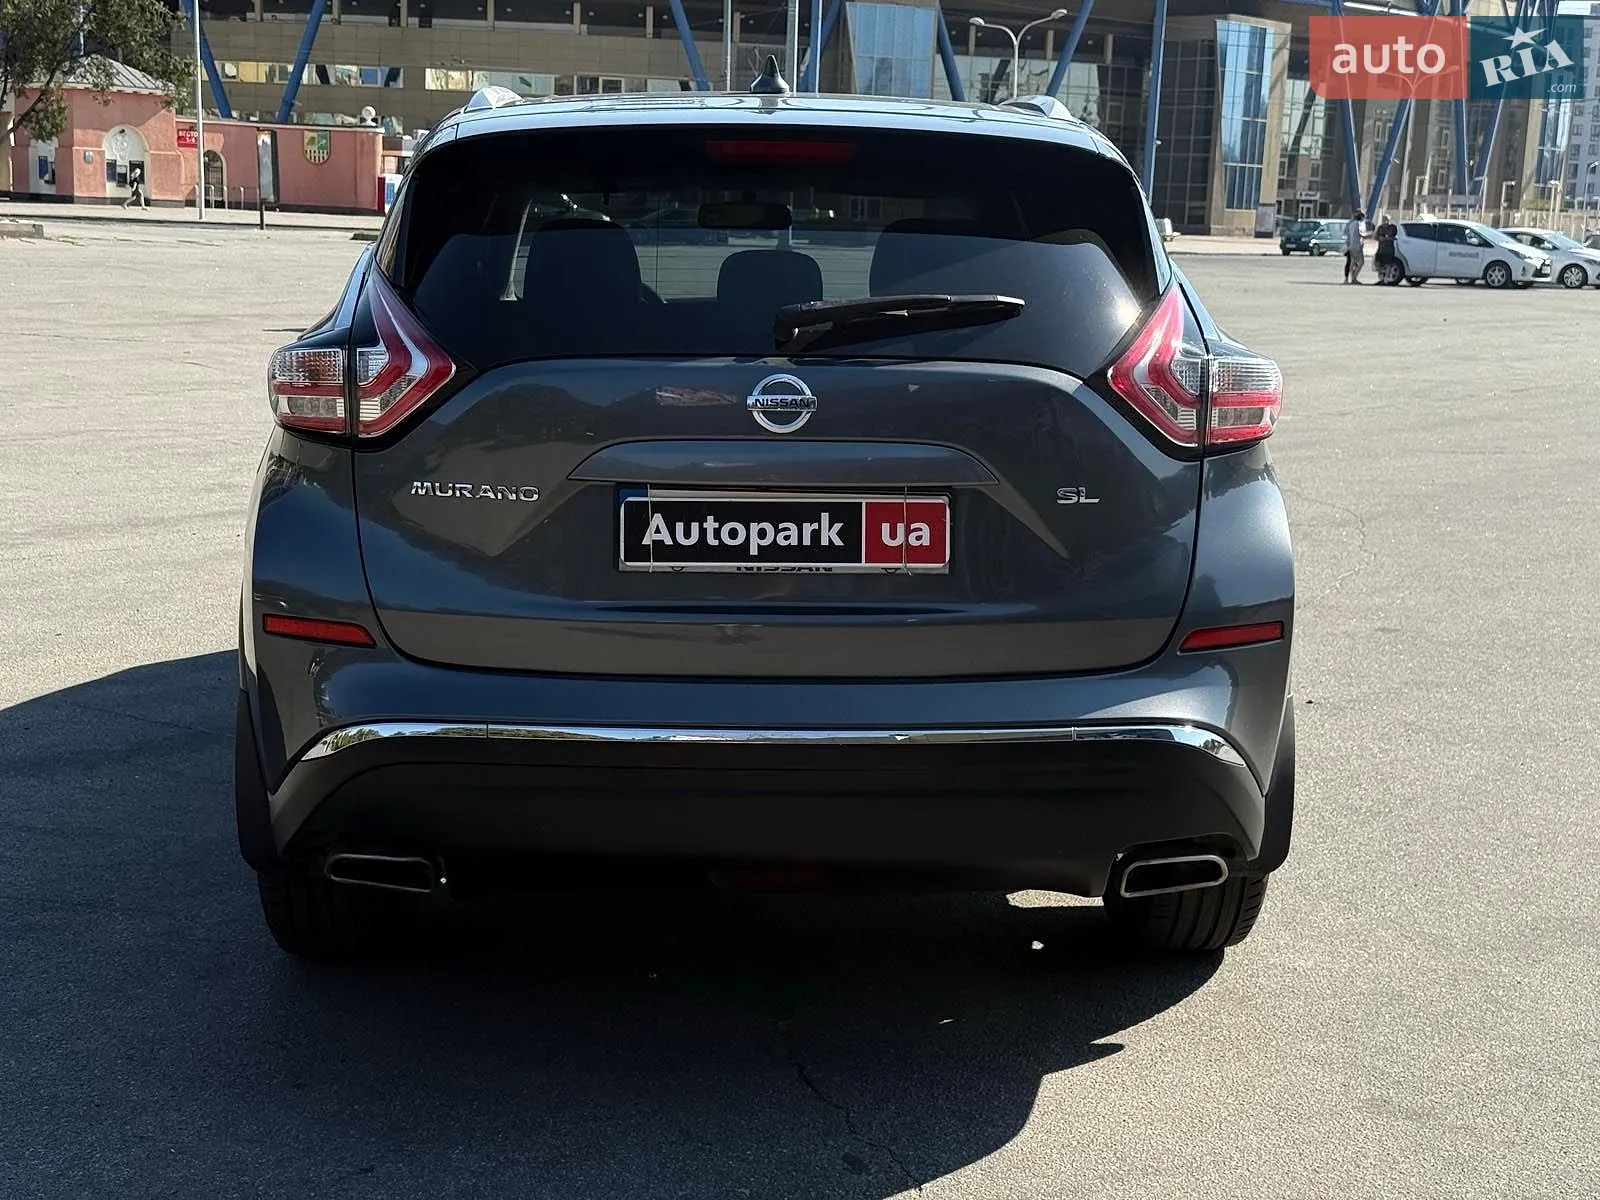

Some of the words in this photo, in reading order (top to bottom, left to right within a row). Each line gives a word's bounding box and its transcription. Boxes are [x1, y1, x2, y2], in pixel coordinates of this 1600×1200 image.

[754, 398, 809, 408] NISSAN
[410, 481, 540, 501] MURANO
[1056, 486, 1101, 504] SL
[641, 512, 845, 556] Autopark
[881, 521, 931, 547] ua
